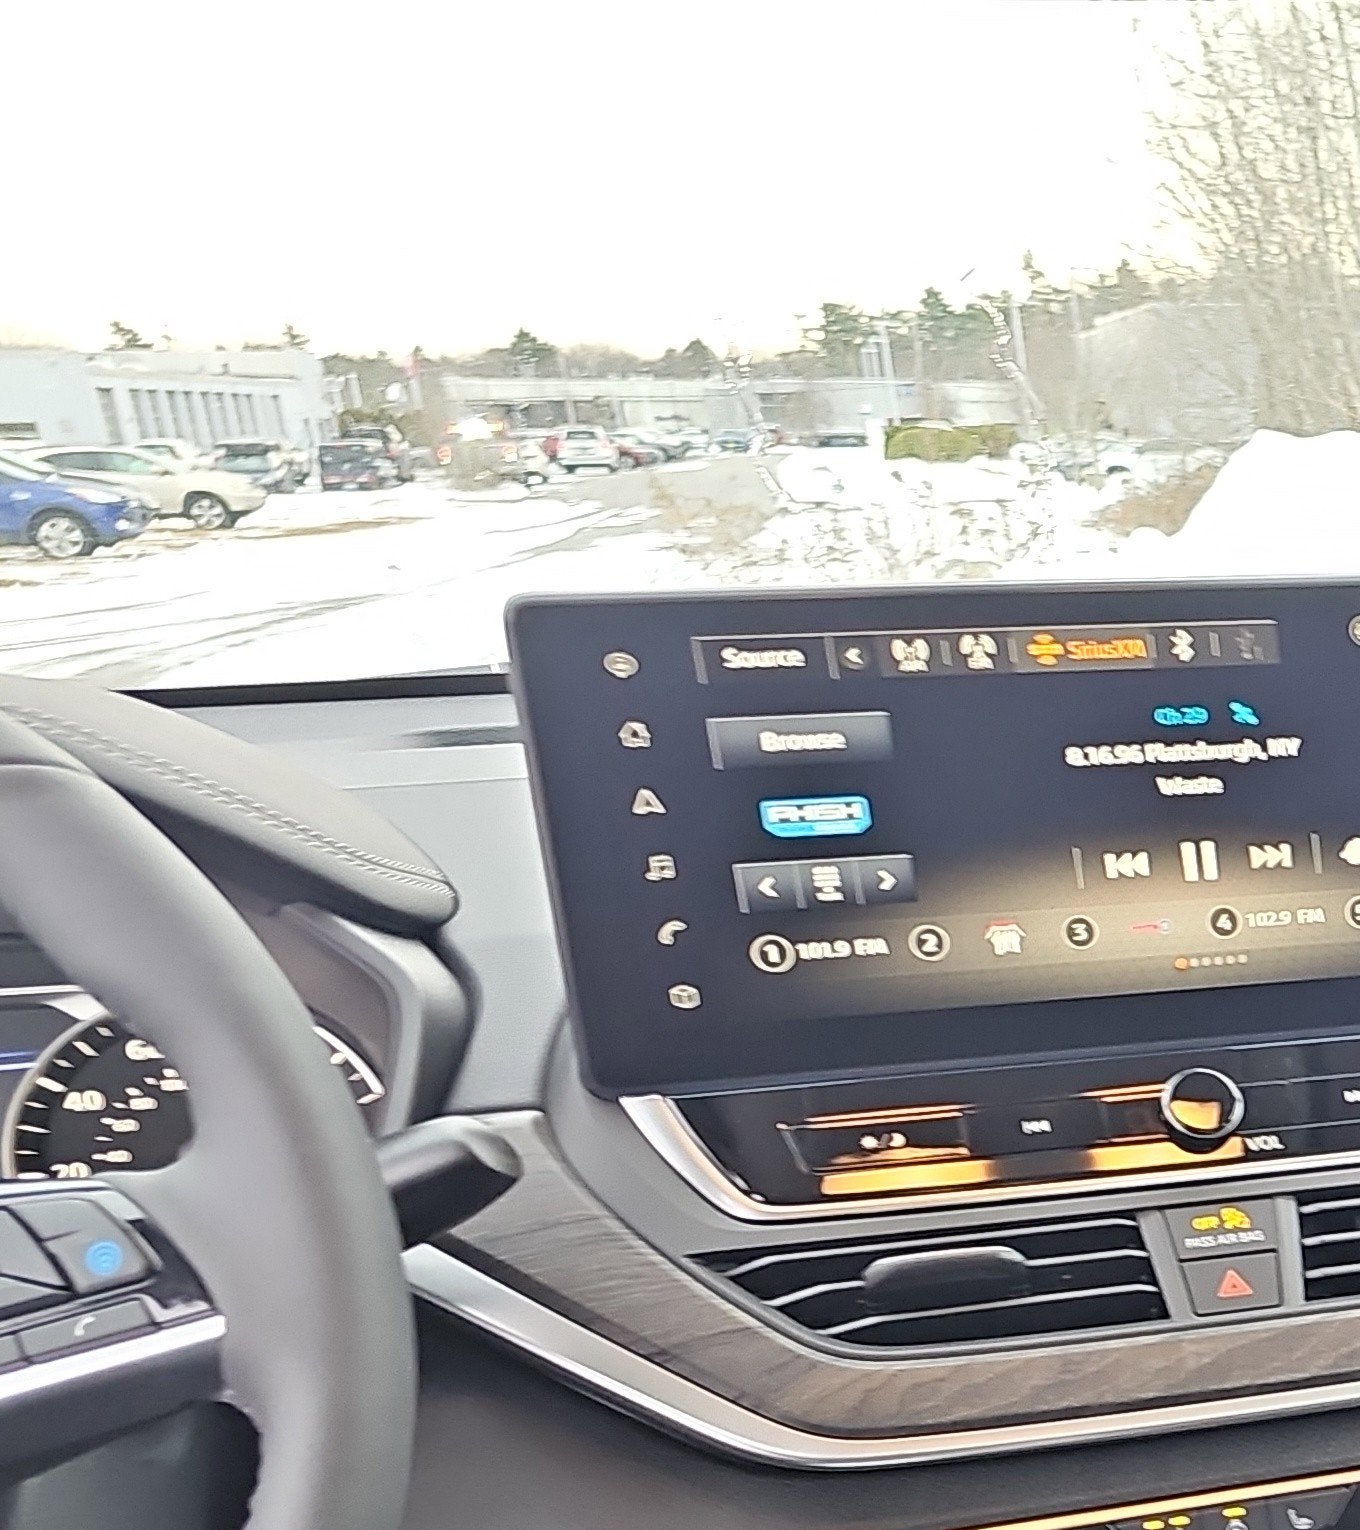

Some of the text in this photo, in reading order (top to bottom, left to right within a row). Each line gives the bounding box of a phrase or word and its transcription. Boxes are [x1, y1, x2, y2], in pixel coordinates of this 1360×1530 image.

[720, 646, 807, 668] Source
[758, 731, 847, 752] Browse
[1266, 737, 1302, 757] NY
[1155, 776, 1225, 796] Waste
[1215, 908, 1327, 931] 4 102.9 FM
[1071, 923, 1090, 941] 3
[762, 937, 891, 963] 1 101.9 FM
[918, 933, 940, 953] 2
[62, 1090, 107, 1111] 40
[1244, 1135, 1286, 1152] VOL
